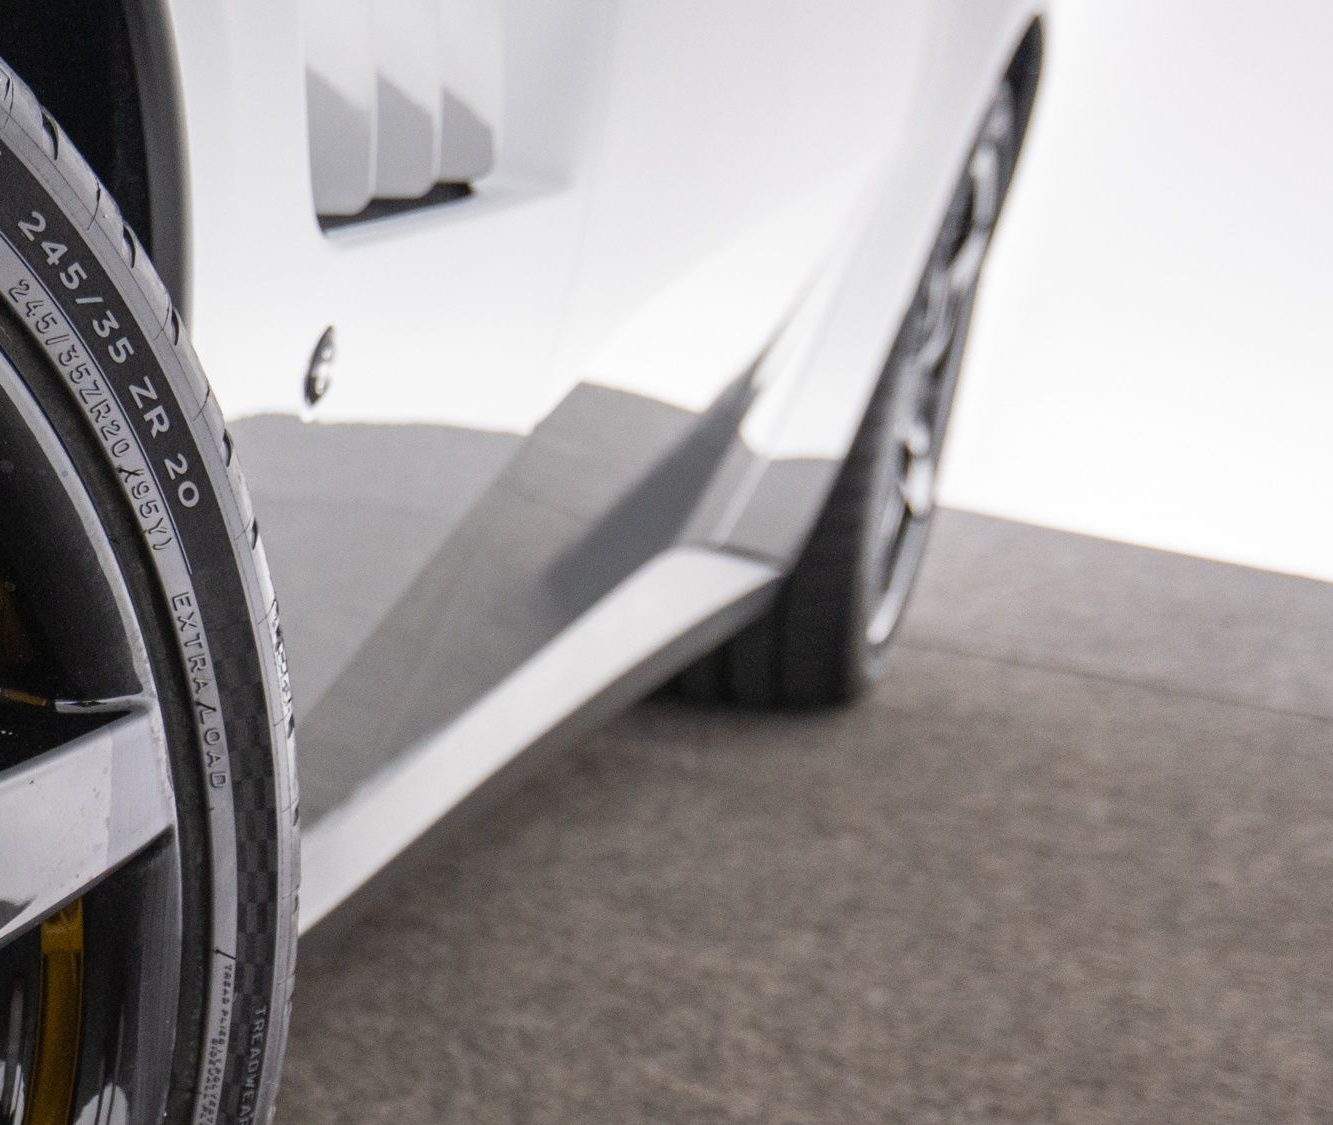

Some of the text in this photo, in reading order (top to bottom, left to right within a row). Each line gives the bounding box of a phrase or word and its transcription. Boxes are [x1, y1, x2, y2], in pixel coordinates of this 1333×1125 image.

[9, 279, 131, 458] 245/35ZR20
[17, 211, 201, 509] 245/35 ZR 20
[171, 591, 227, 789] EXTRA LOAD
